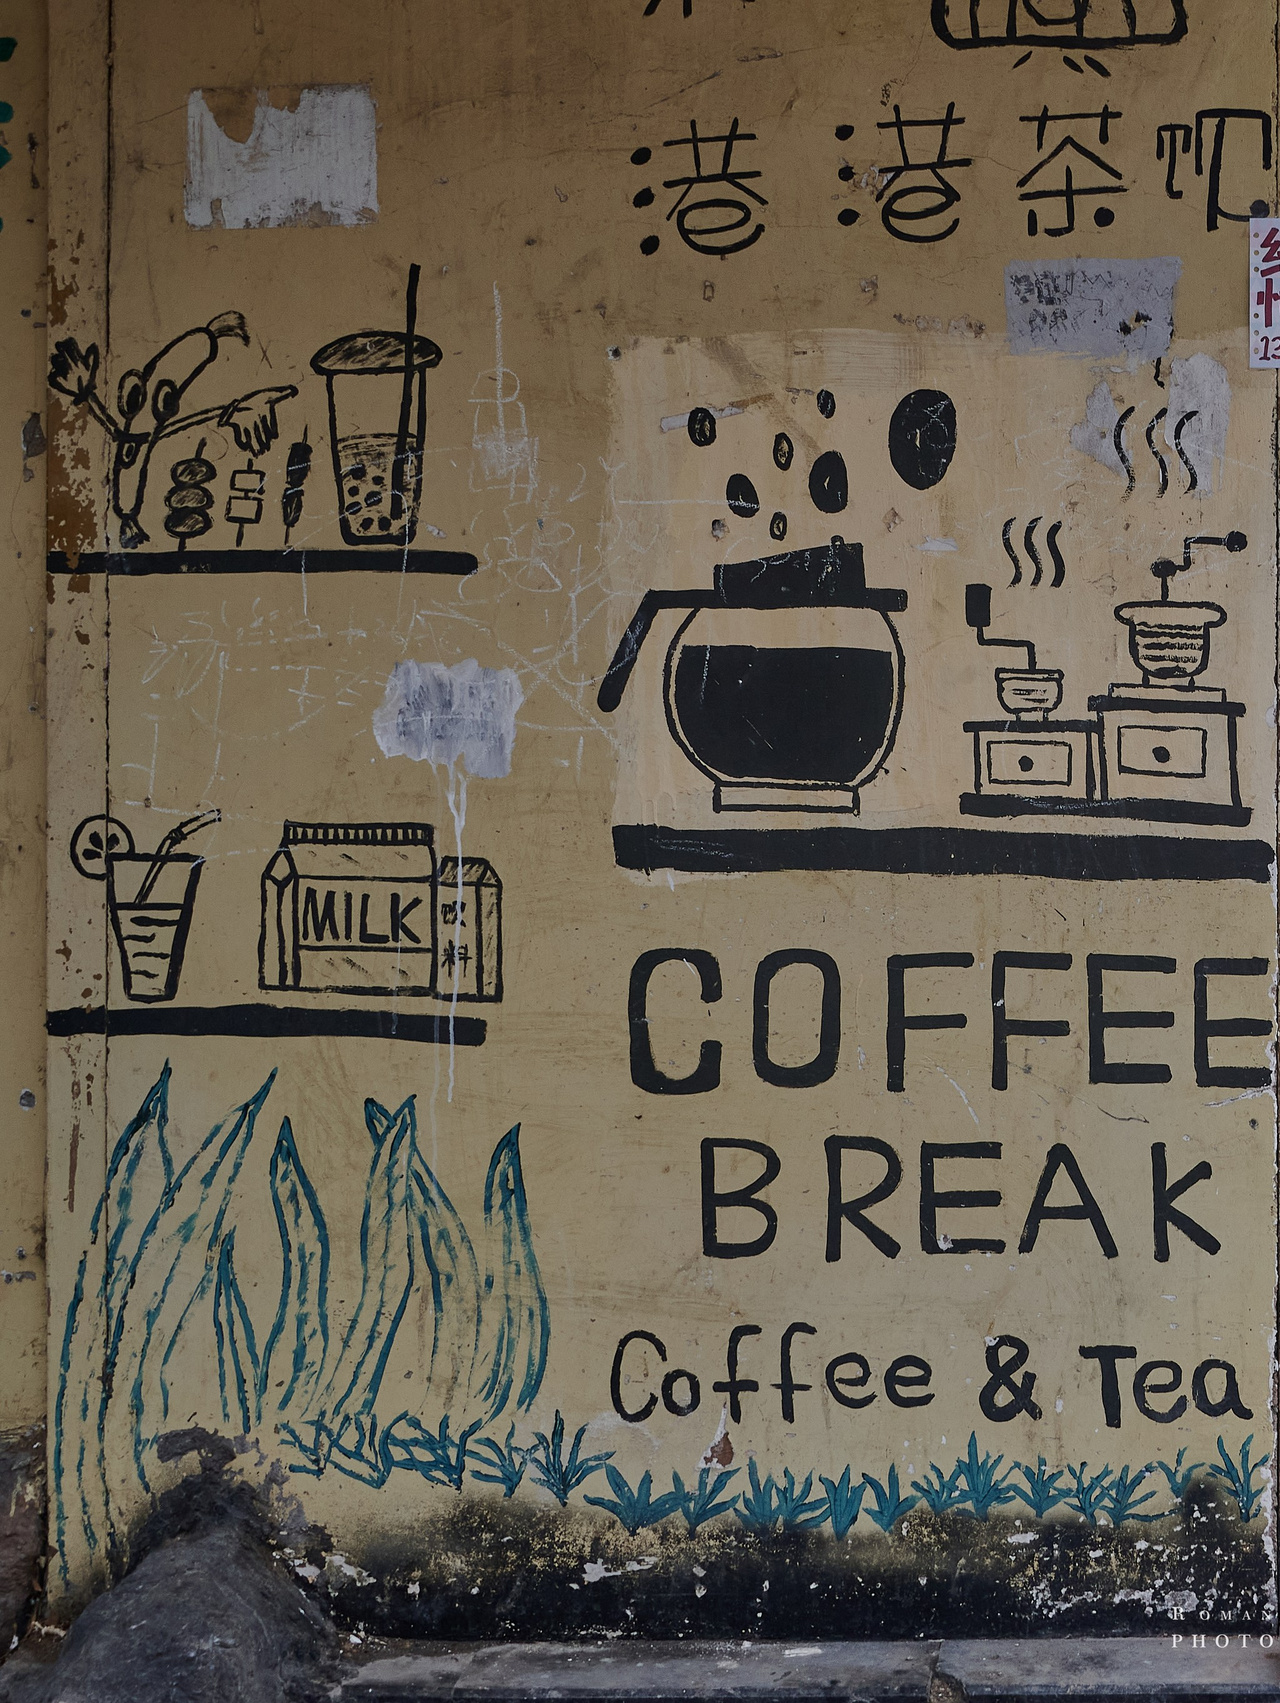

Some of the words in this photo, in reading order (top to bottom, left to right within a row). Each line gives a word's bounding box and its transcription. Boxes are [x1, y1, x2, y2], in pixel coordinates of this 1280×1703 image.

[302, 886, 423, 944] MILK
[628, 947, 1273, 1096] COFFEE
[701, 1134, 1222, 1263] BREAK
[609, 1322, 937, 1424] Coffee
[978, 1335, 1043, 1422] &
[1079, 1344, 1254, 1429] Tea
